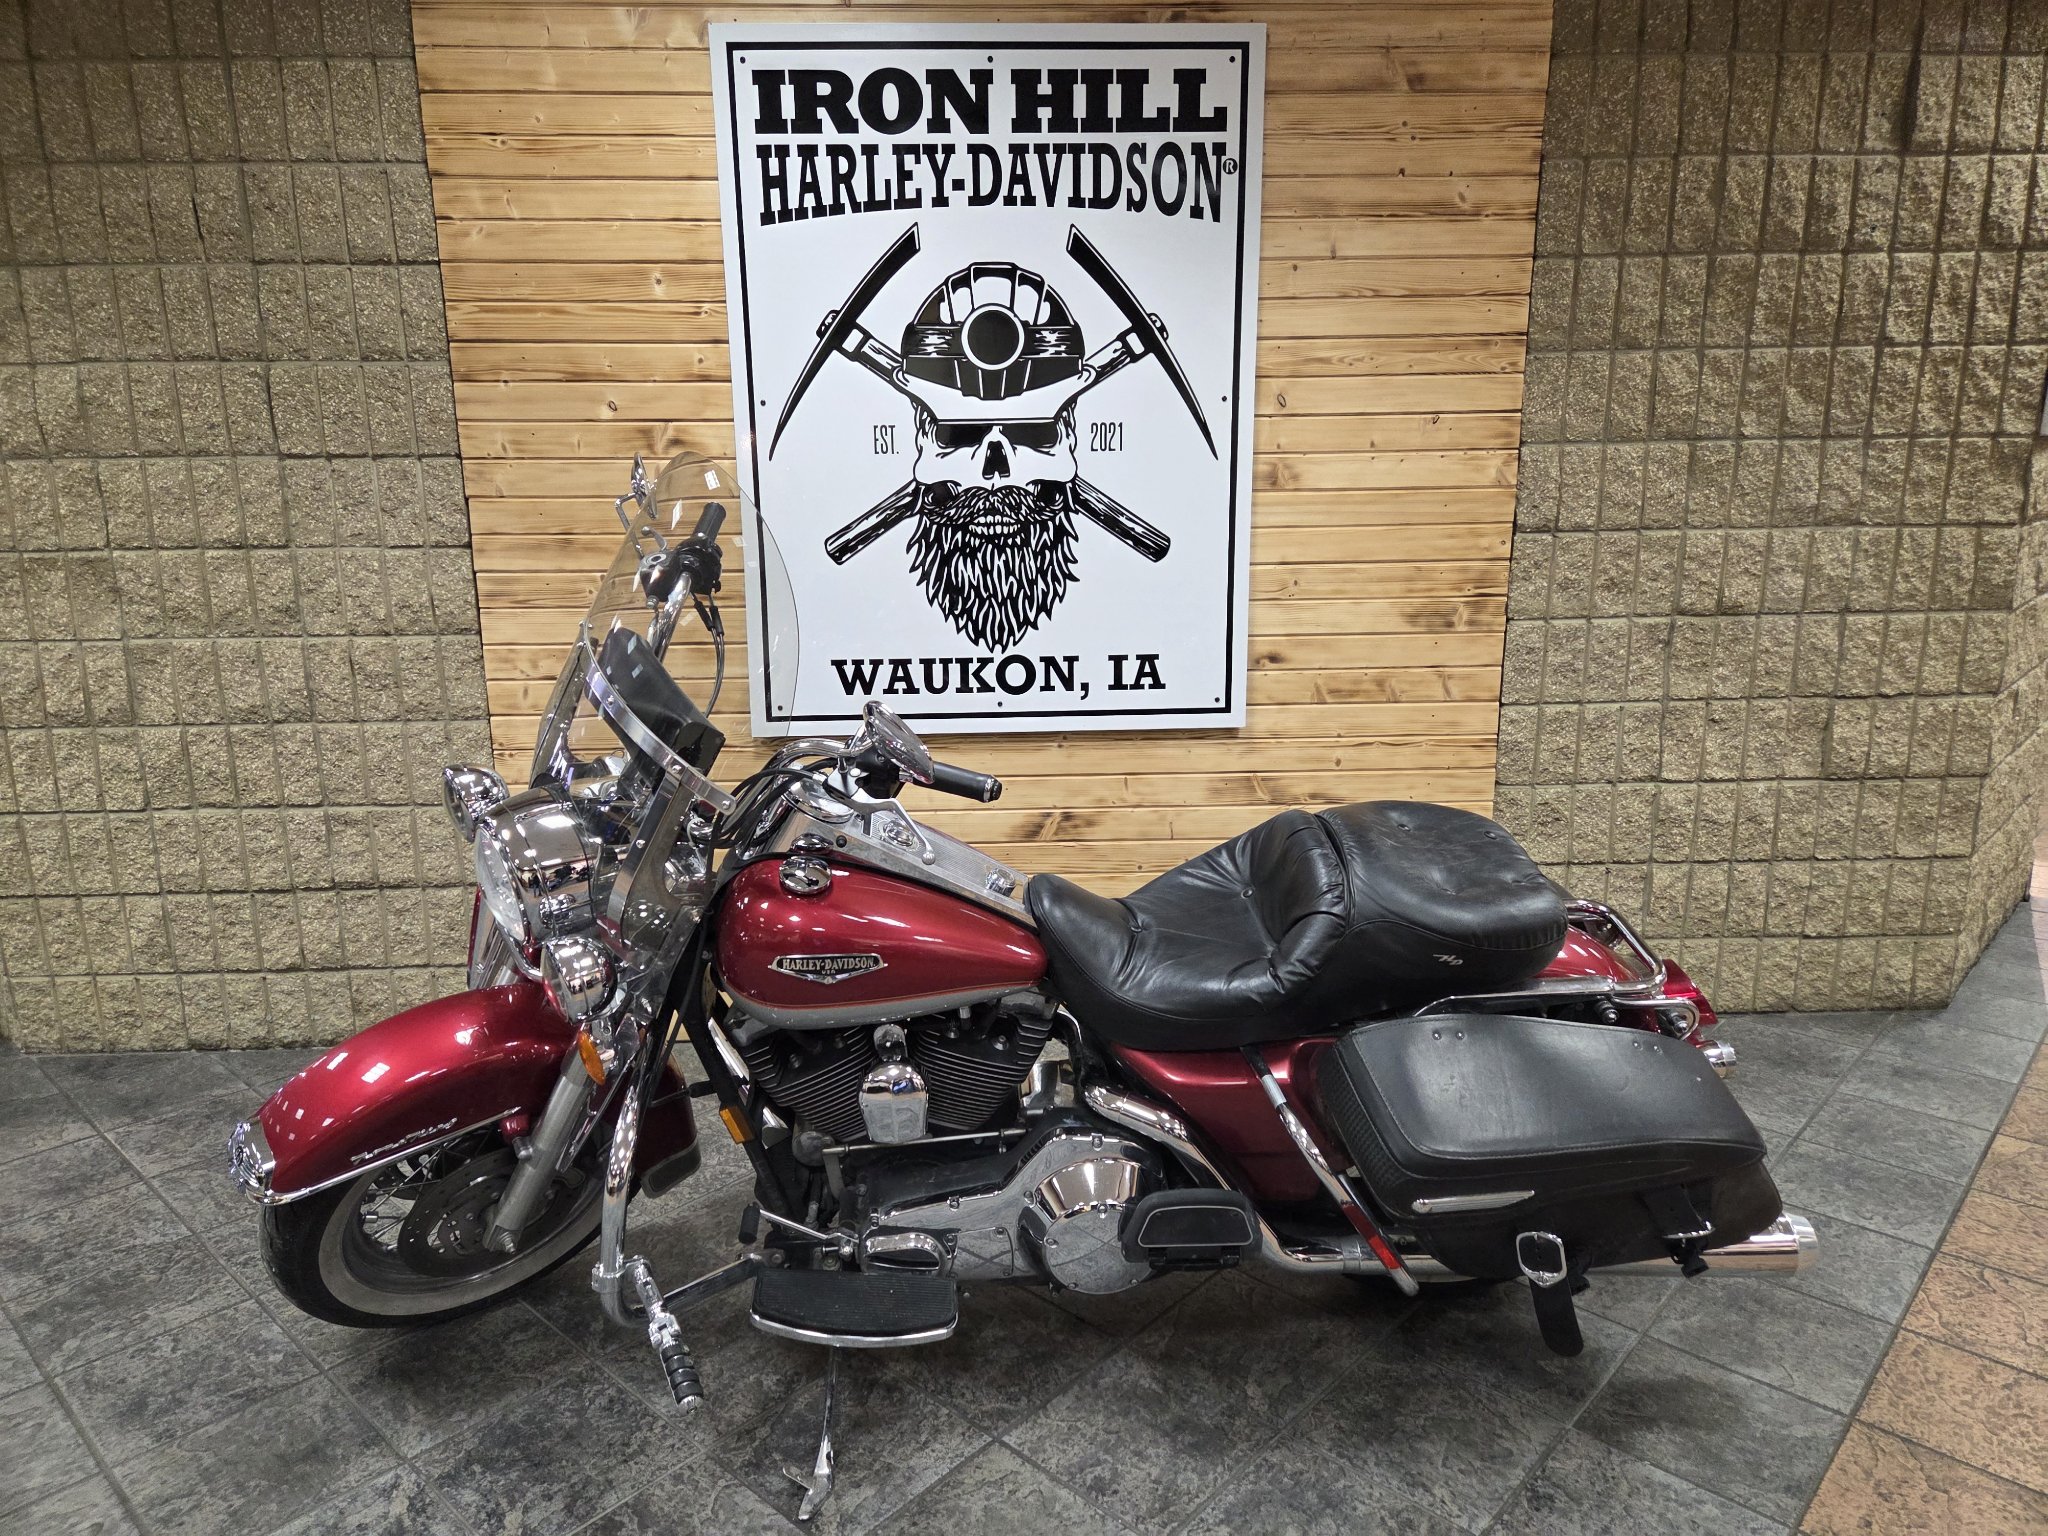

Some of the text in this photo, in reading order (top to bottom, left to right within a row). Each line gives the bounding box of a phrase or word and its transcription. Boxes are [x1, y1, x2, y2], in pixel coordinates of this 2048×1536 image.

[751, 67, 1228, 135] IRON HILL
[873, 424, 900, 455] EST.
[1090, 422, 1124, 452] 2021
[831, 653, 1166, 700] WAUKON, IA
